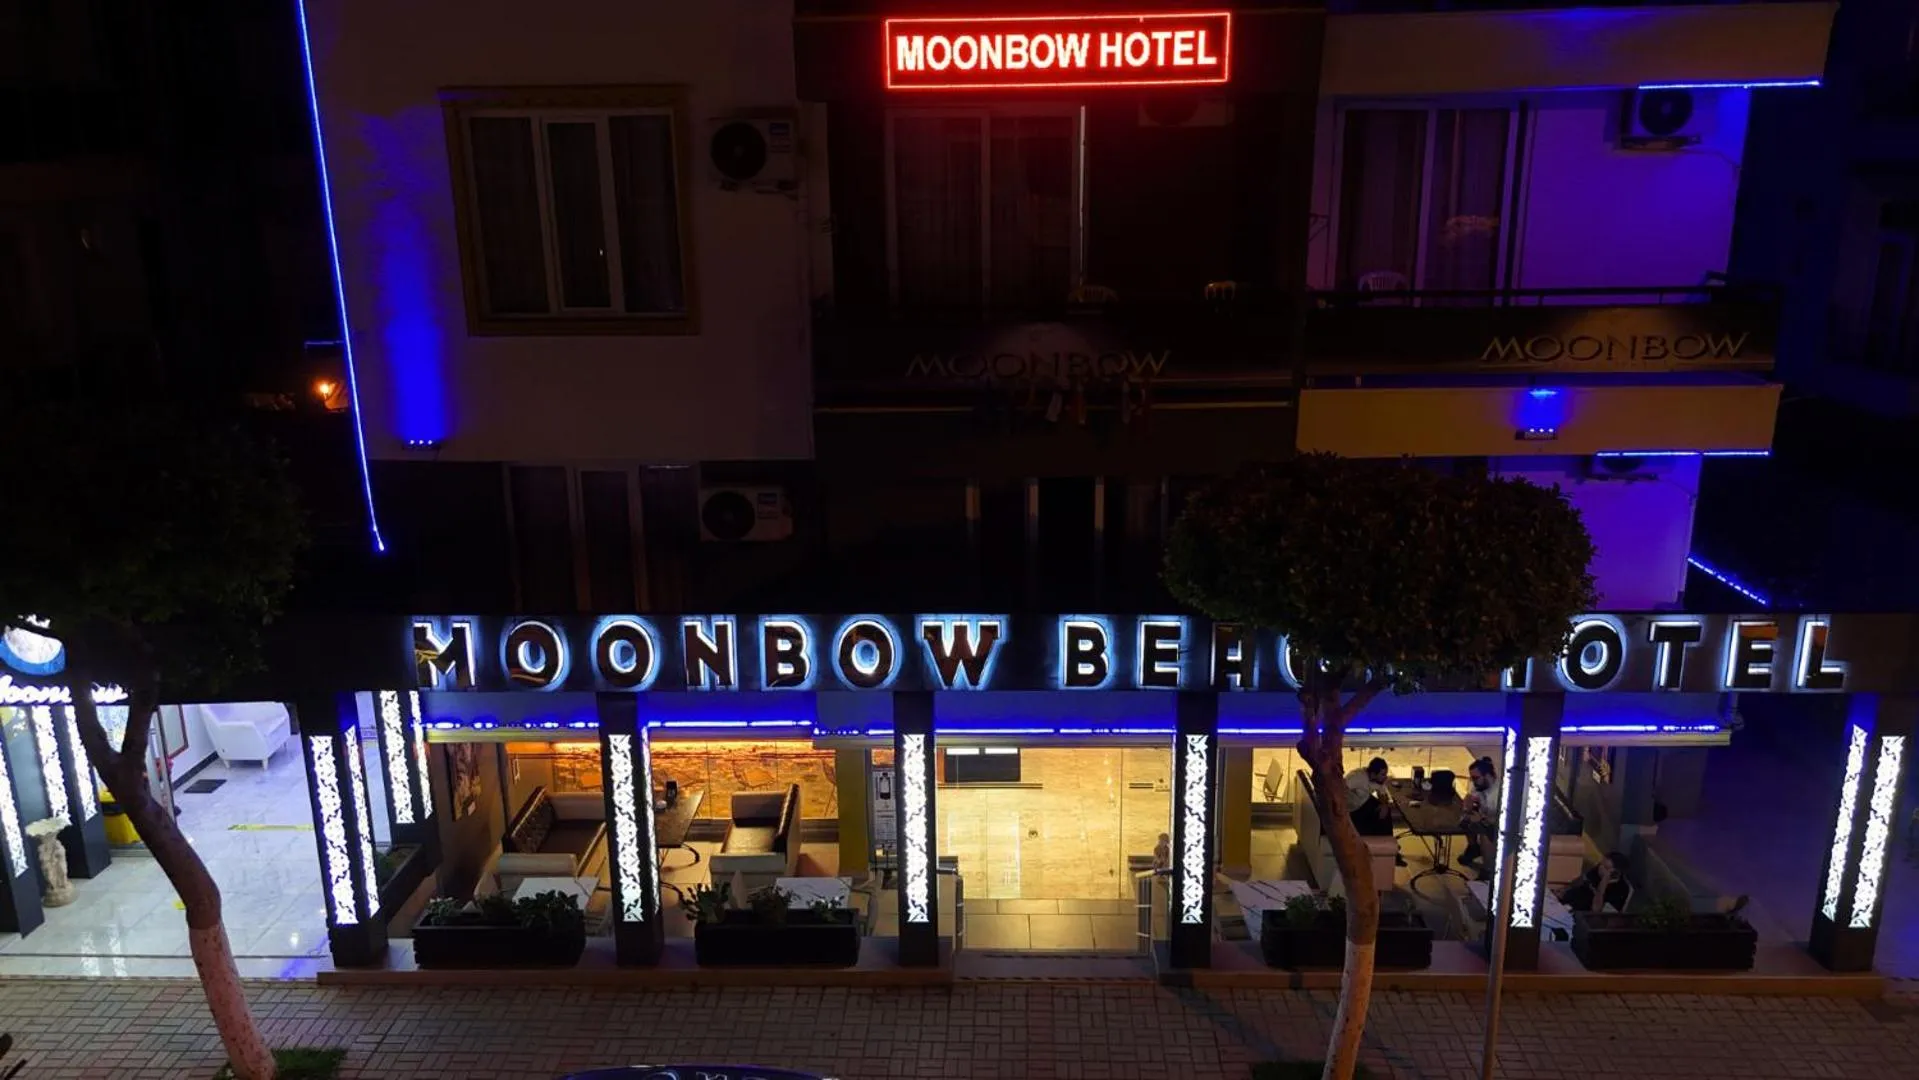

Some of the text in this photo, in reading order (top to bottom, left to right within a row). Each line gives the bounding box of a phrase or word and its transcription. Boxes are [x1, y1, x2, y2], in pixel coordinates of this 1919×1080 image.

[895, 30, 1218, 71] MOONBOW HOTEL
[905, 347, 1172, 378] MOONBOW
[1480, 331, 1751, 361] MOONBOW
[411, 619, 1003, 690] MOONBOW
[1062, 618, 1402, 691] BEA
